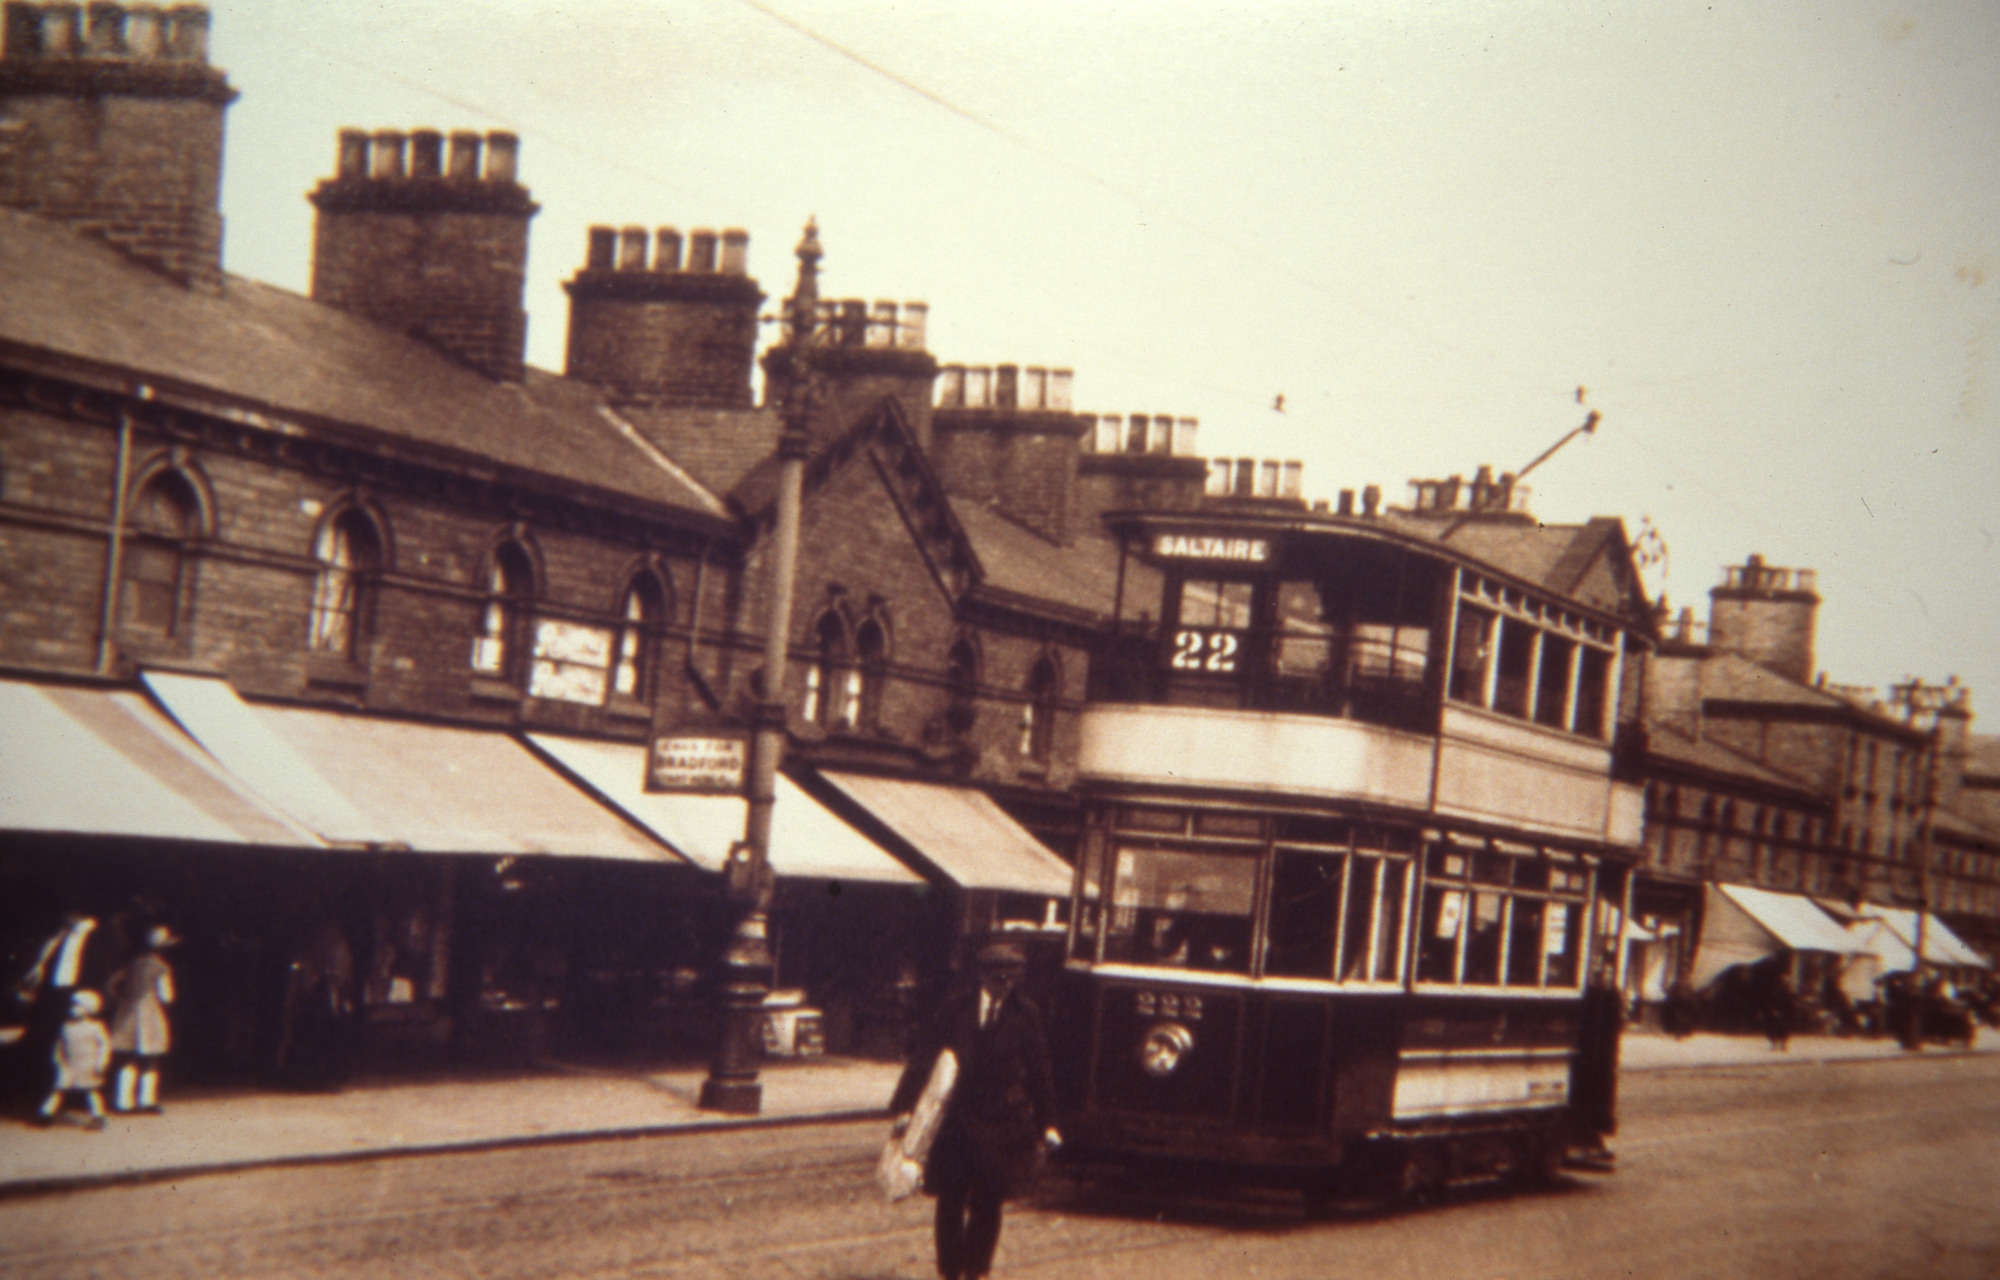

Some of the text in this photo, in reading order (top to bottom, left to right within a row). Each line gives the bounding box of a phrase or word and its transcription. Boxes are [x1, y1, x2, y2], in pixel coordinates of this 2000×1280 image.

[1157, 535, 1267, 562] SALTAIRE
[1172, 632, 1237, 672] 22
[655, 756, 739, 771] BRADFORD
